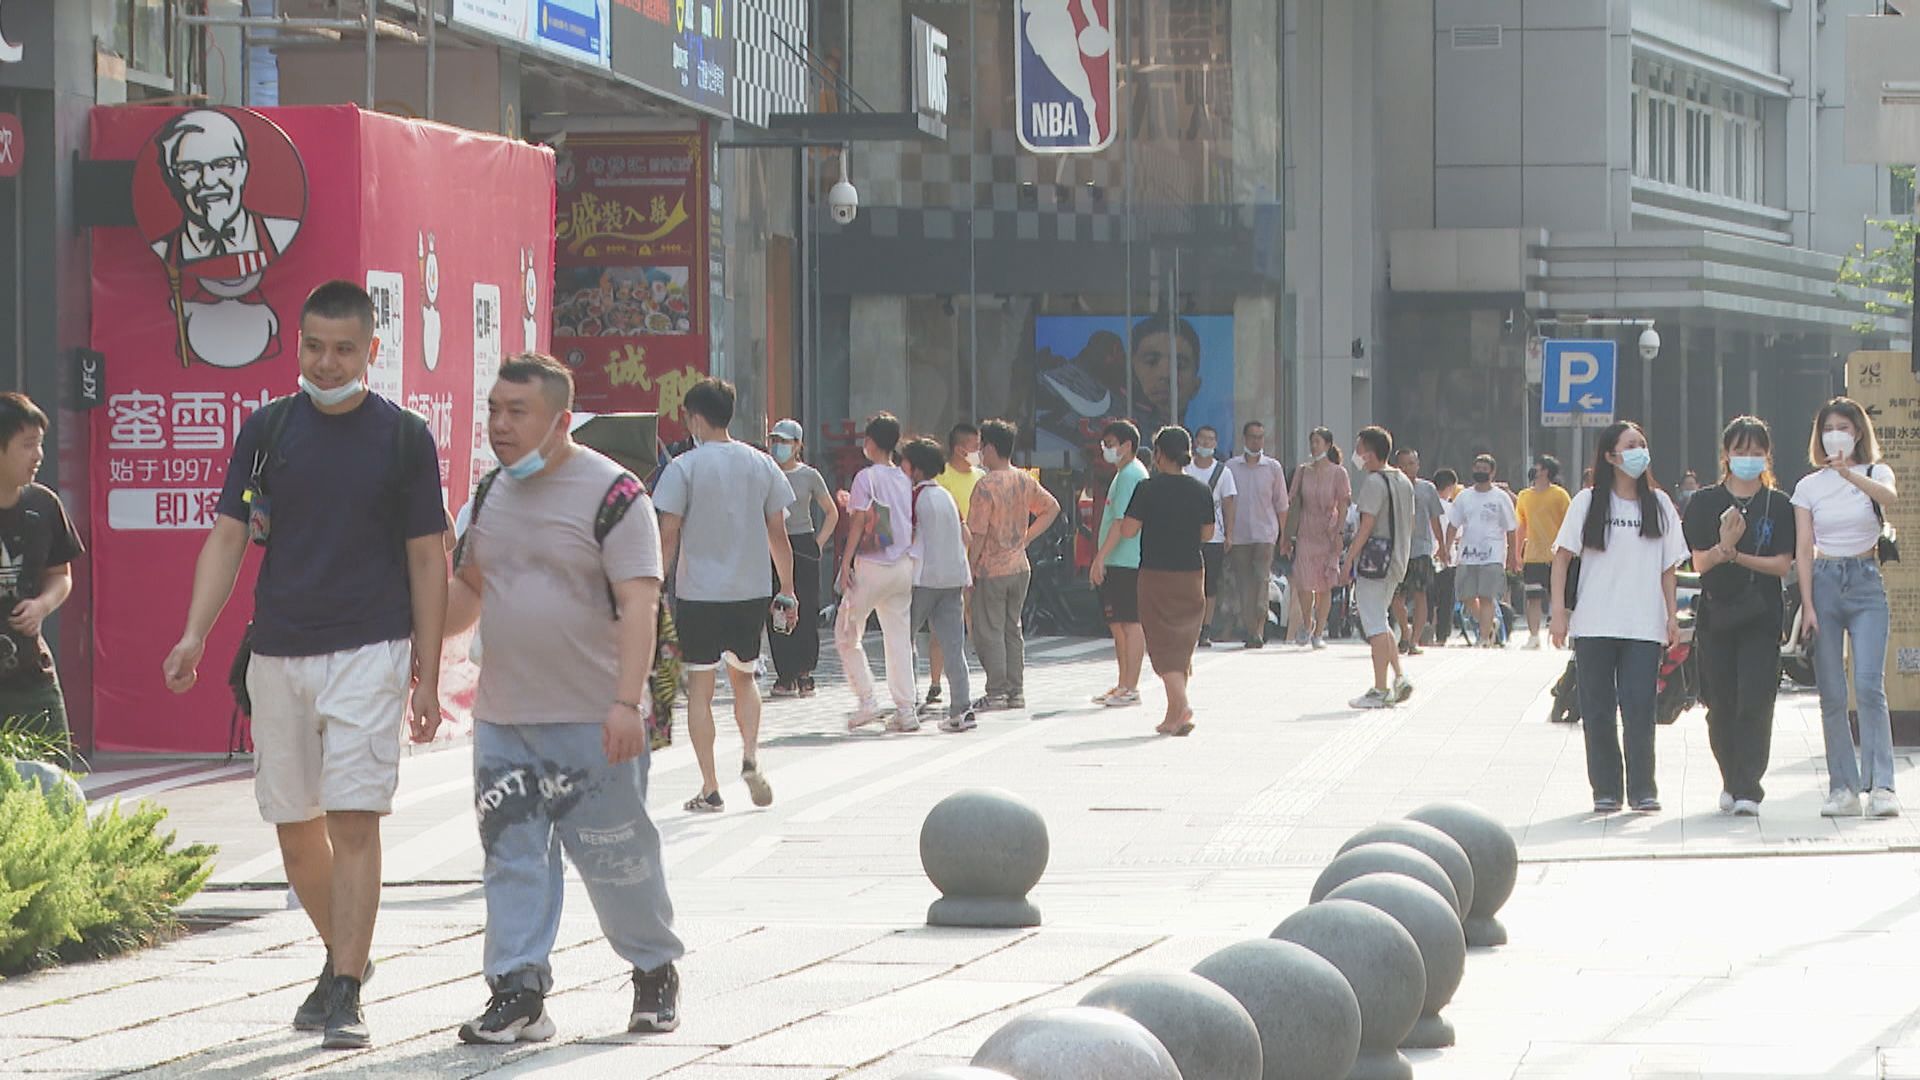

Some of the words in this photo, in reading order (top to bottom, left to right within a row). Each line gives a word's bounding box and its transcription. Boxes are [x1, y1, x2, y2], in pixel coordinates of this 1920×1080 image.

[1032, 102, 1078, 137] NBA
[83, 360, 97, 400] KFC
[1559, 352, 1599, 403] P
